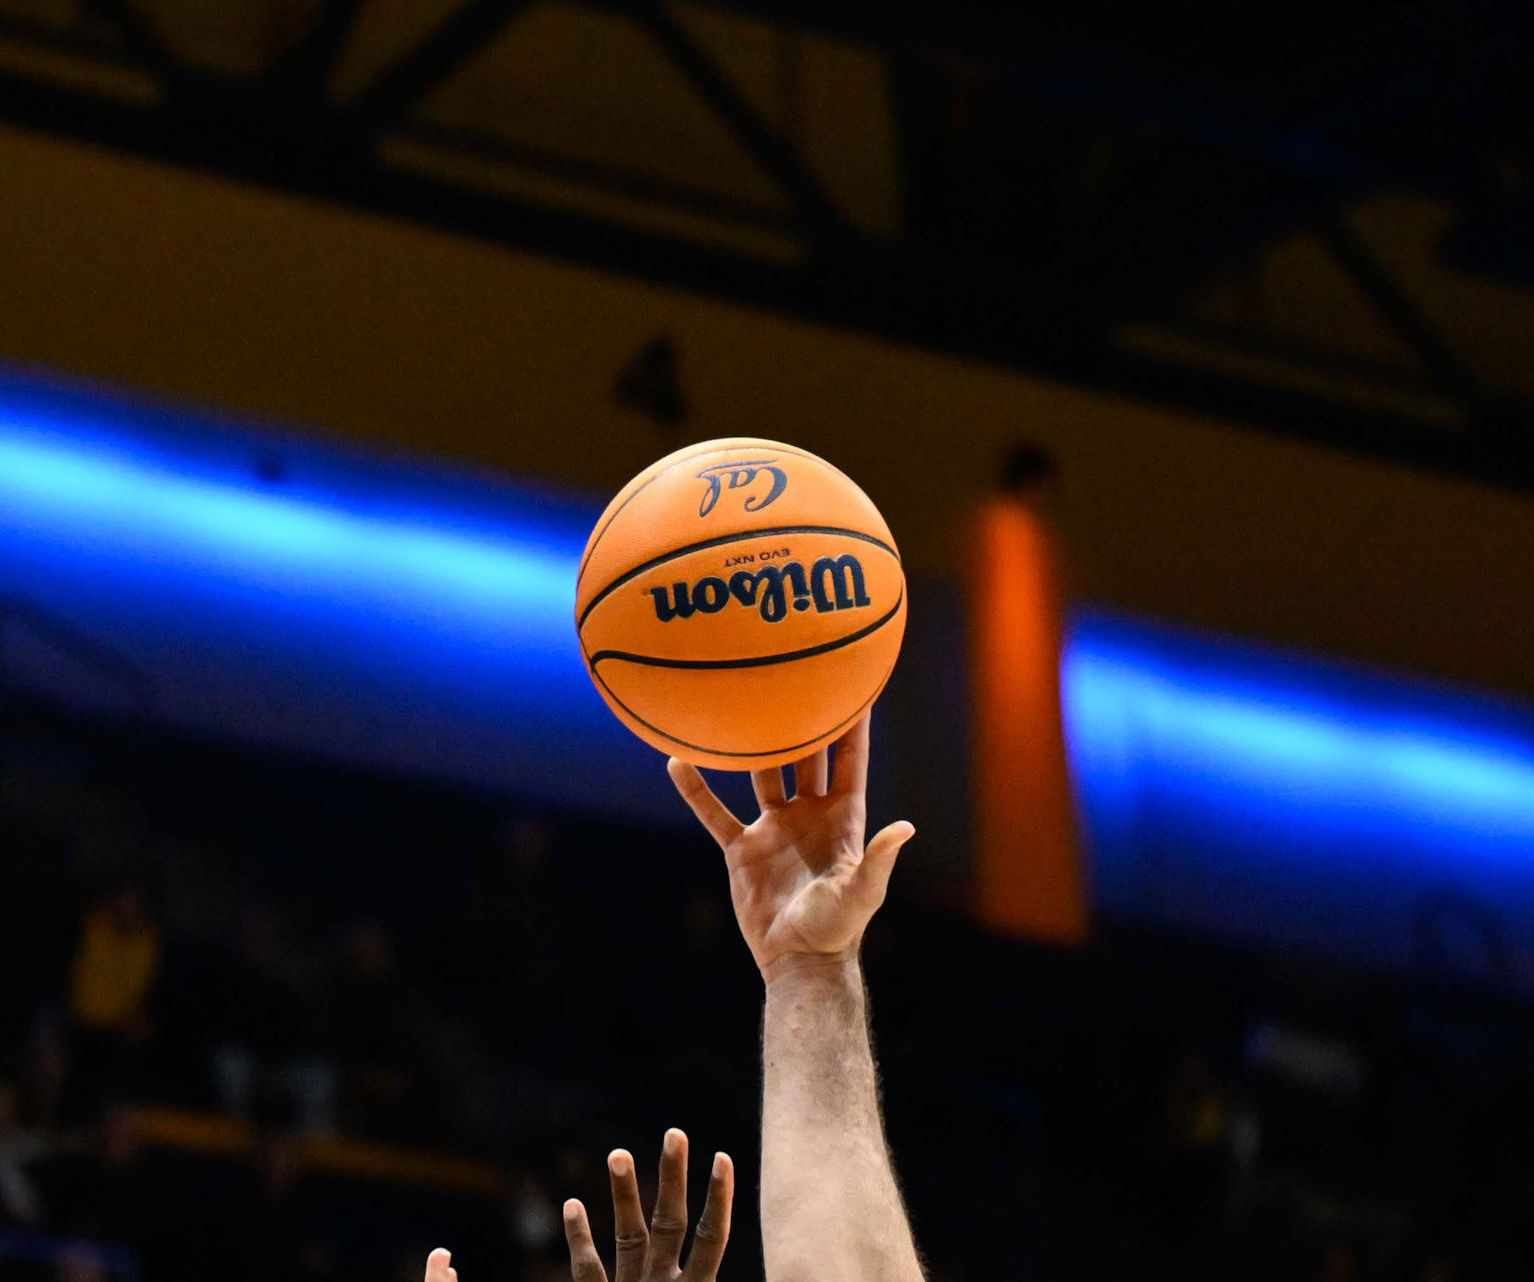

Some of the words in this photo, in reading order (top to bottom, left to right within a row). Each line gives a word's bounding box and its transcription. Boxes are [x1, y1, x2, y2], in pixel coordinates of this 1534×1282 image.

[696, 459, 788, 518] Cal
[725, 555, 755, 567] NXT
[759, 548, 791, 562] EVO
[650, 553, 871, 623] Wilson
